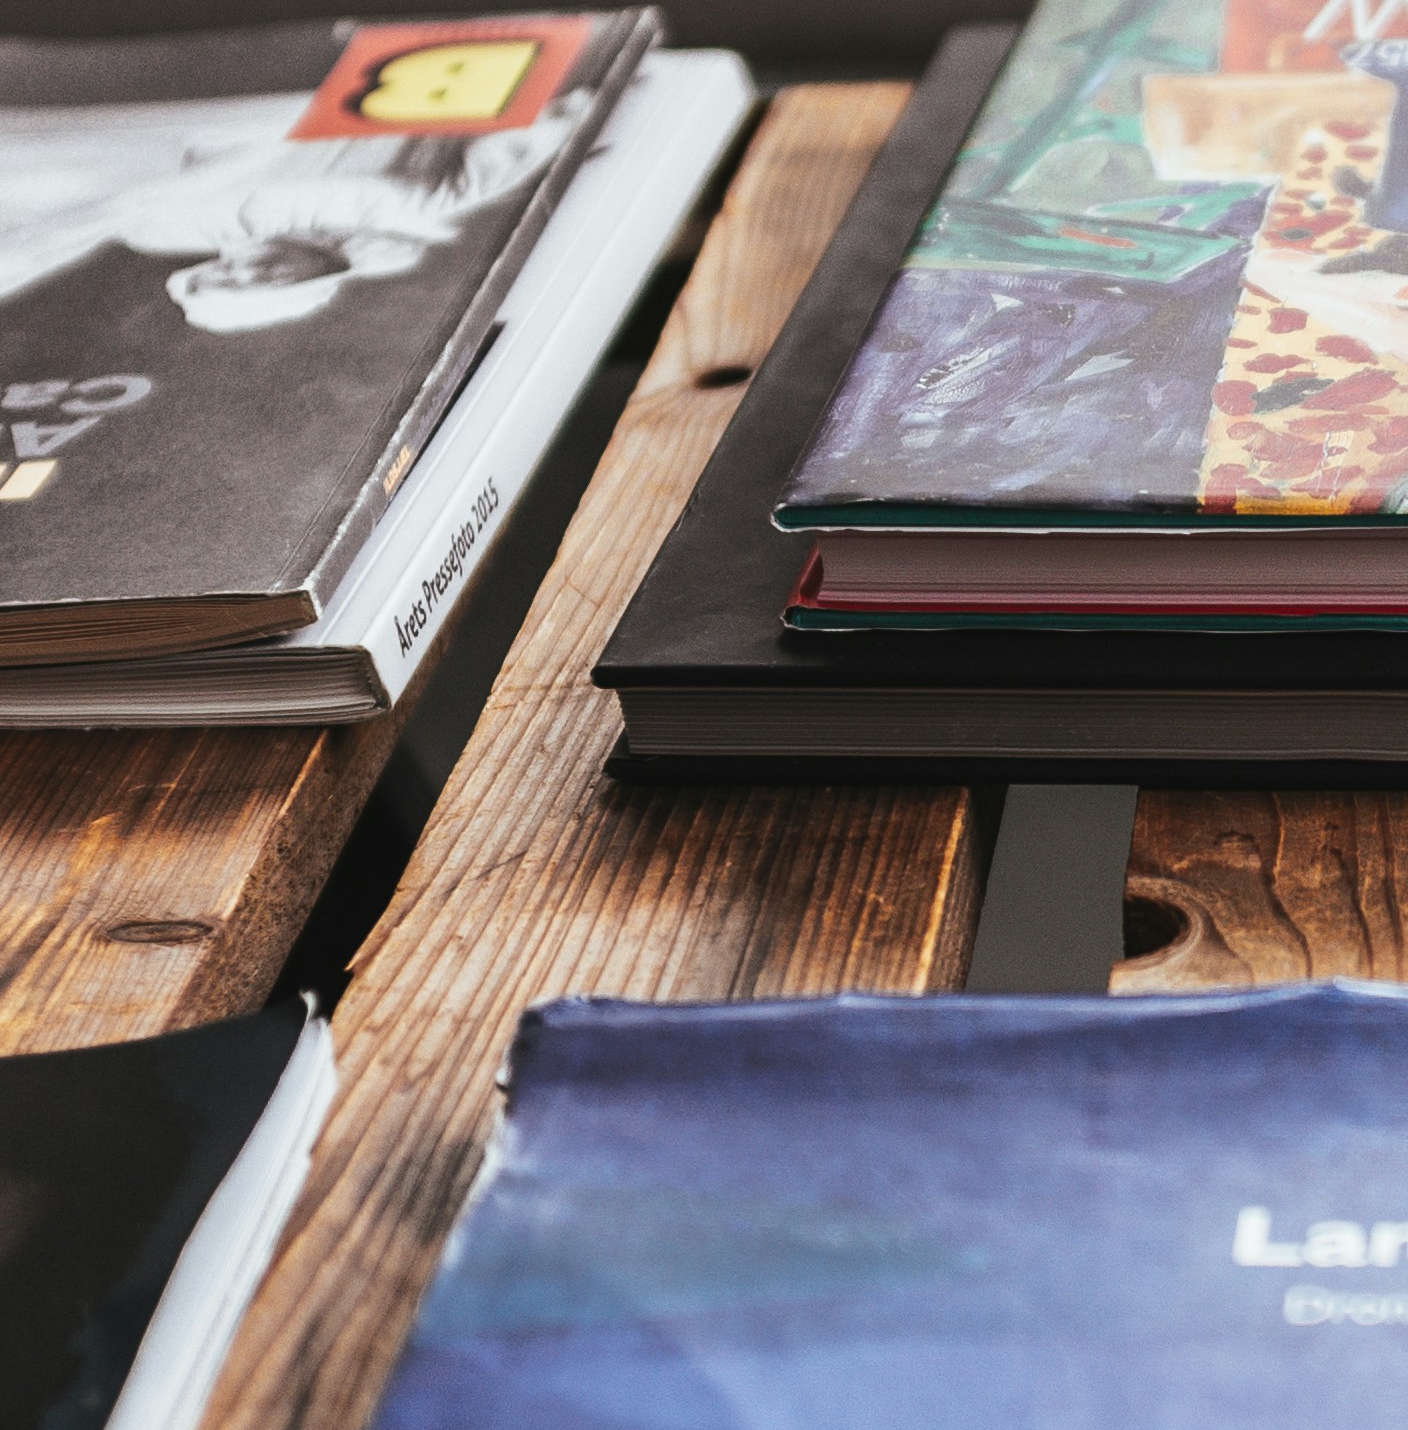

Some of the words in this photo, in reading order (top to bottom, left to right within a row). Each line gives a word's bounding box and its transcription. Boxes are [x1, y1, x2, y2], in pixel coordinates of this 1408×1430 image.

[393, 599, 429, 658] Årets
[421, 521, 476, 615] Pressefoto
[471, 476, 501, 534] 2015
